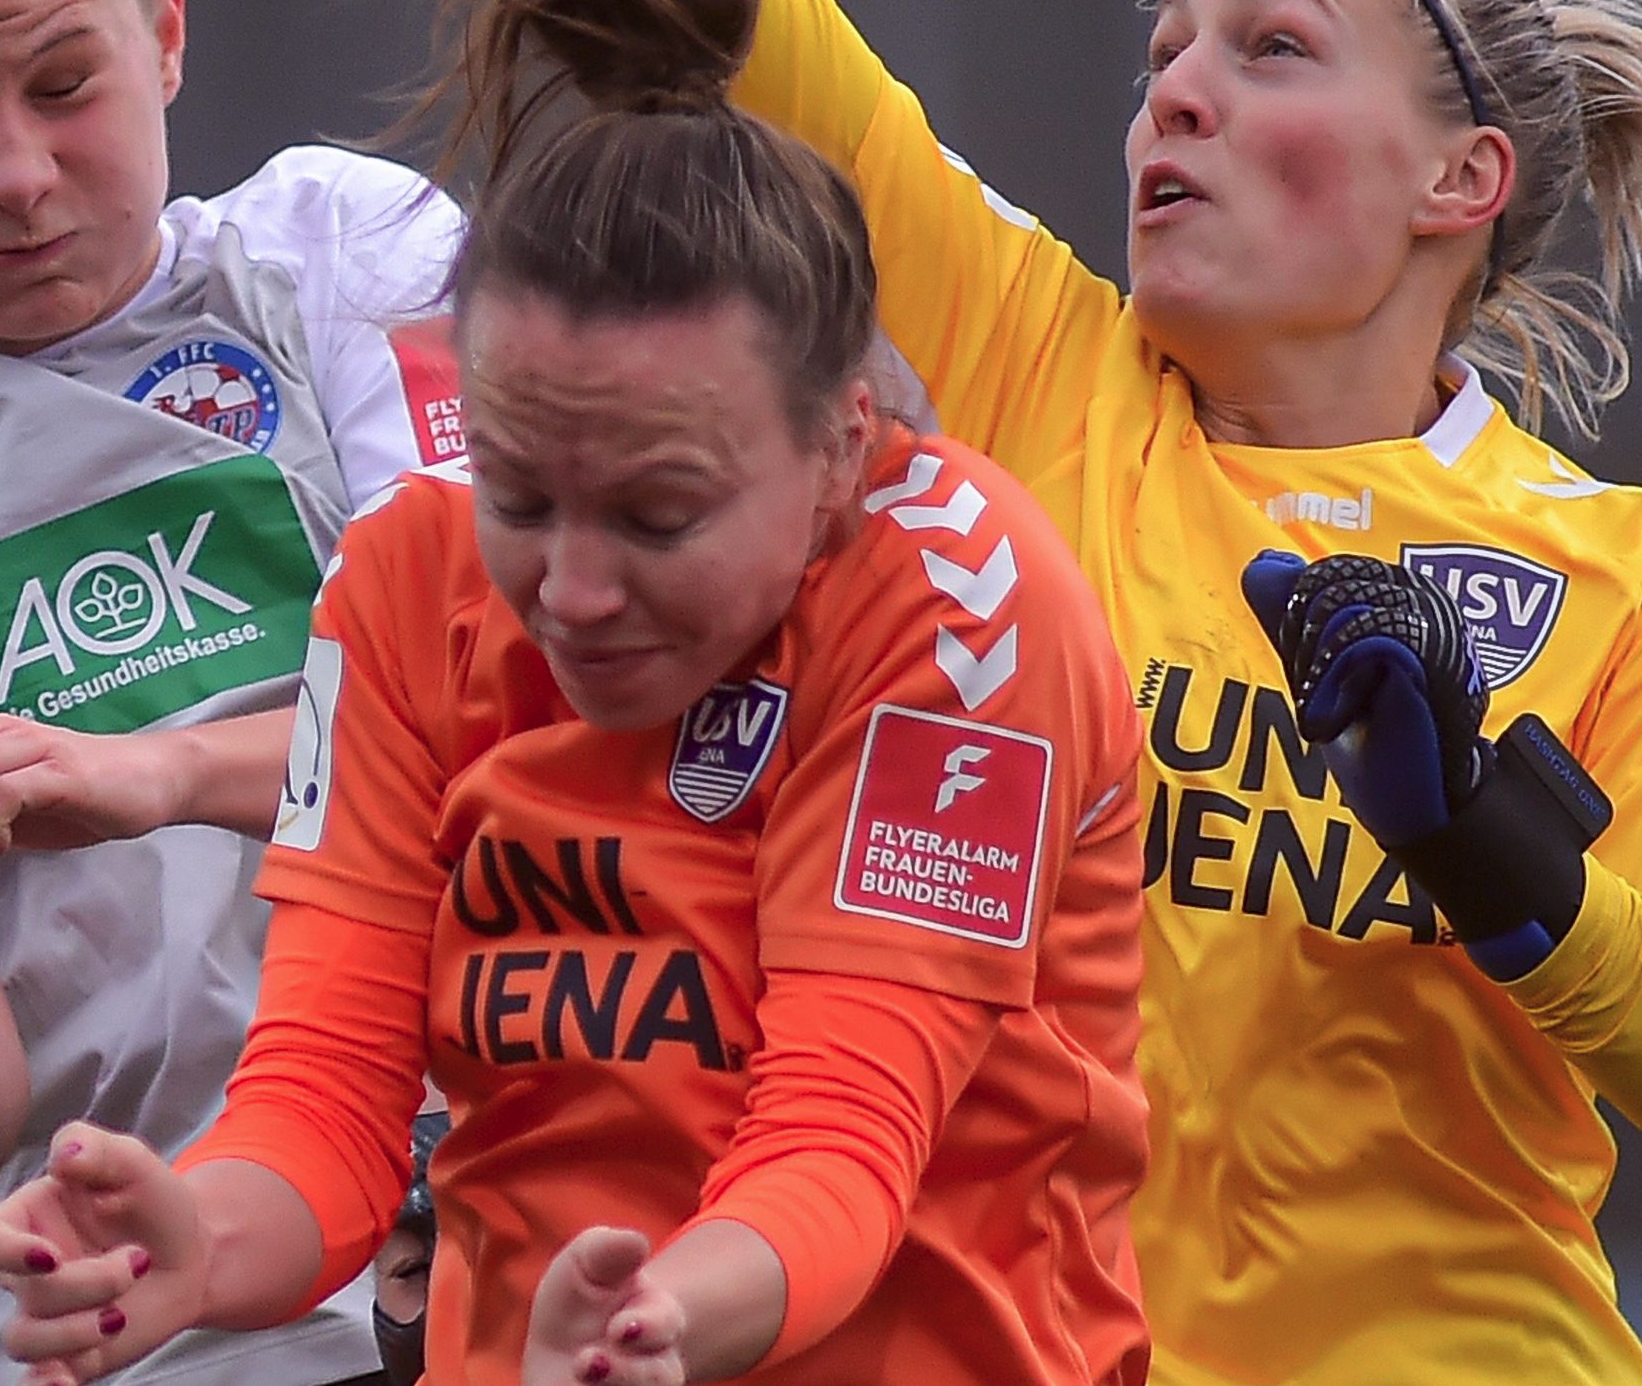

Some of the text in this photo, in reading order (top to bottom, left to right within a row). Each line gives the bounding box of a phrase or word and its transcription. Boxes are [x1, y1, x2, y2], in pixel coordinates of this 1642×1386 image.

[177, 343, 214, 365] FFC
[37, 620, 267, 718] Gesundheitskasse.
[1135, 657, 1167, 710] www.
[1151, 664, 1329, 802] UN
[864, 845, 974, 886] FRAUEN-
[868, 820, 1020, 873] FLYERALARM
[860, 870, 1010, 923] BUNDESLIGA
